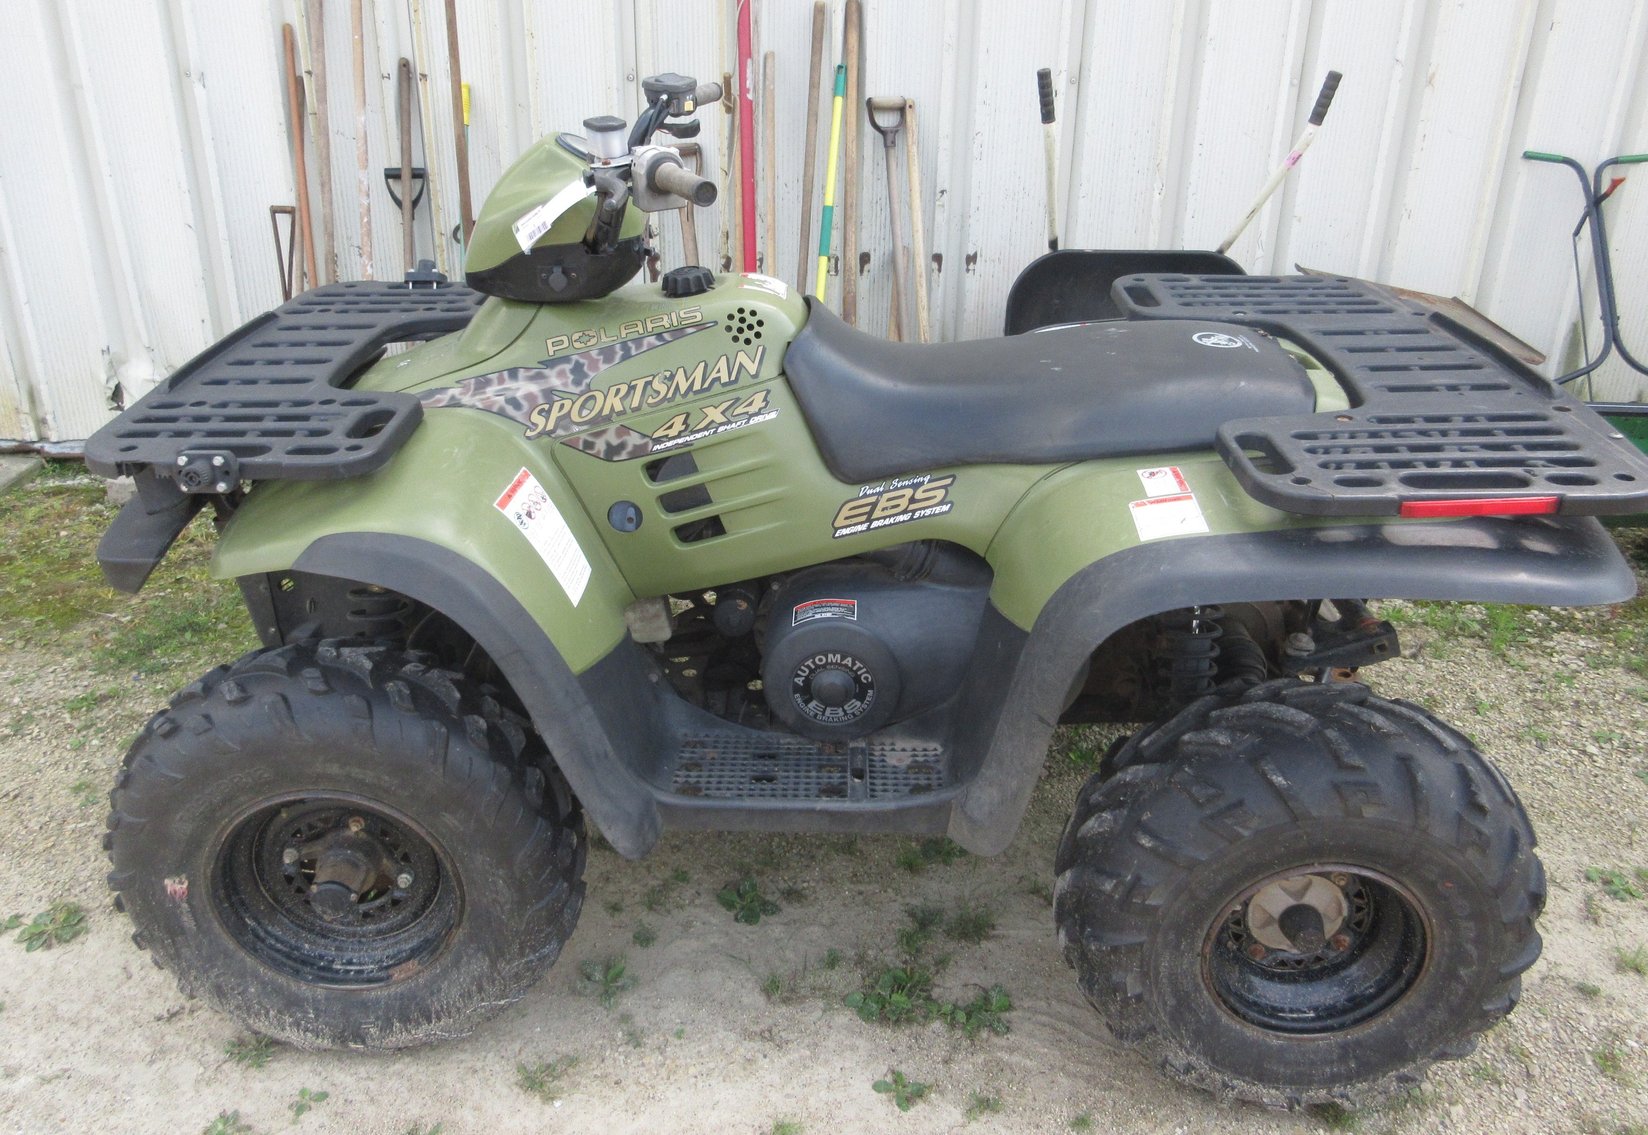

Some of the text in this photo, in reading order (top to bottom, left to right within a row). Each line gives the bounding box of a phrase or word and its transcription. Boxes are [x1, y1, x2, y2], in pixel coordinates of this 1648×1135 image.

[546, 306, 703, 356] POLARIS
[525, 345, 766, 439] SPORTSMAN
[652, 428, 716, 451] INDEPENDENT
[717, 419, 747, 432] SHAFT
[859, 474, 932, 497] Dual Sensing
[833, 477, 954, 528] EBS
[834, 504, 951, 537] ENGINE BRAKING SYSTEM
[794, 653, 872, 687] AUTOMATIC
[794, 689, 874, 722] ENGINE BRAKING SYSTEM
[807, 698, 862, 717] EBS
